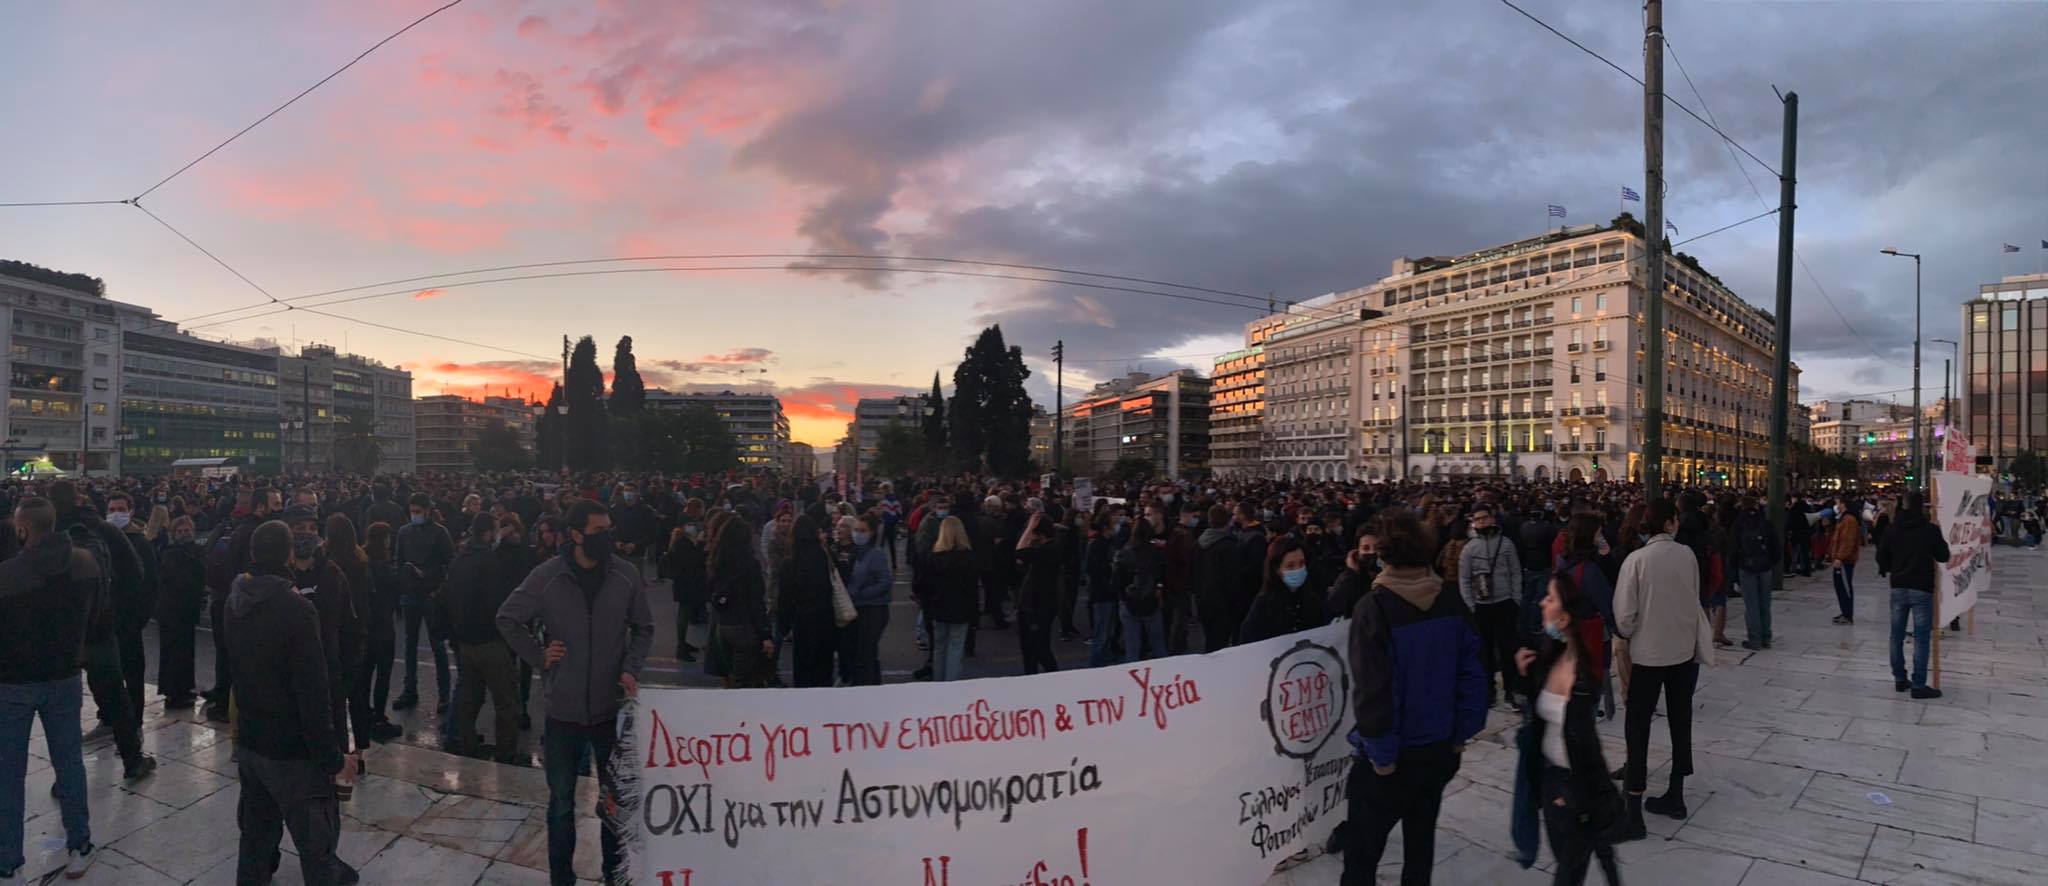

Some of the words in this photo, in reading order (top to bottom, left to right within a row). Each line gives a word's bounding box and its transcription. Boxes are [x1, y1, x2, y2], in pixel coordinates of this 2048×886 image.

[645, 708, 752, 780] Λεφτά
[759, 722, 811, 782] για
[822, 721, 890, 753] την
[897, 698, 1046, 750] εκπαίδευση
[1055, 703, 1073, 731] &
[1077, 696, 1124, 726] την
[1129, 667, 1201, 730] Υγεία
[1279, 671, 1328, 712] ΣΜΦ
[1288, 703, 1329, 741] ΕΜΠ
[643, 783, 715, 836] ΟΧΙ
[723, 798, 767, 849] για
[769, 799, 824, 829] την
[834, 756, 1102, 831] Αστυνομοκρατία
